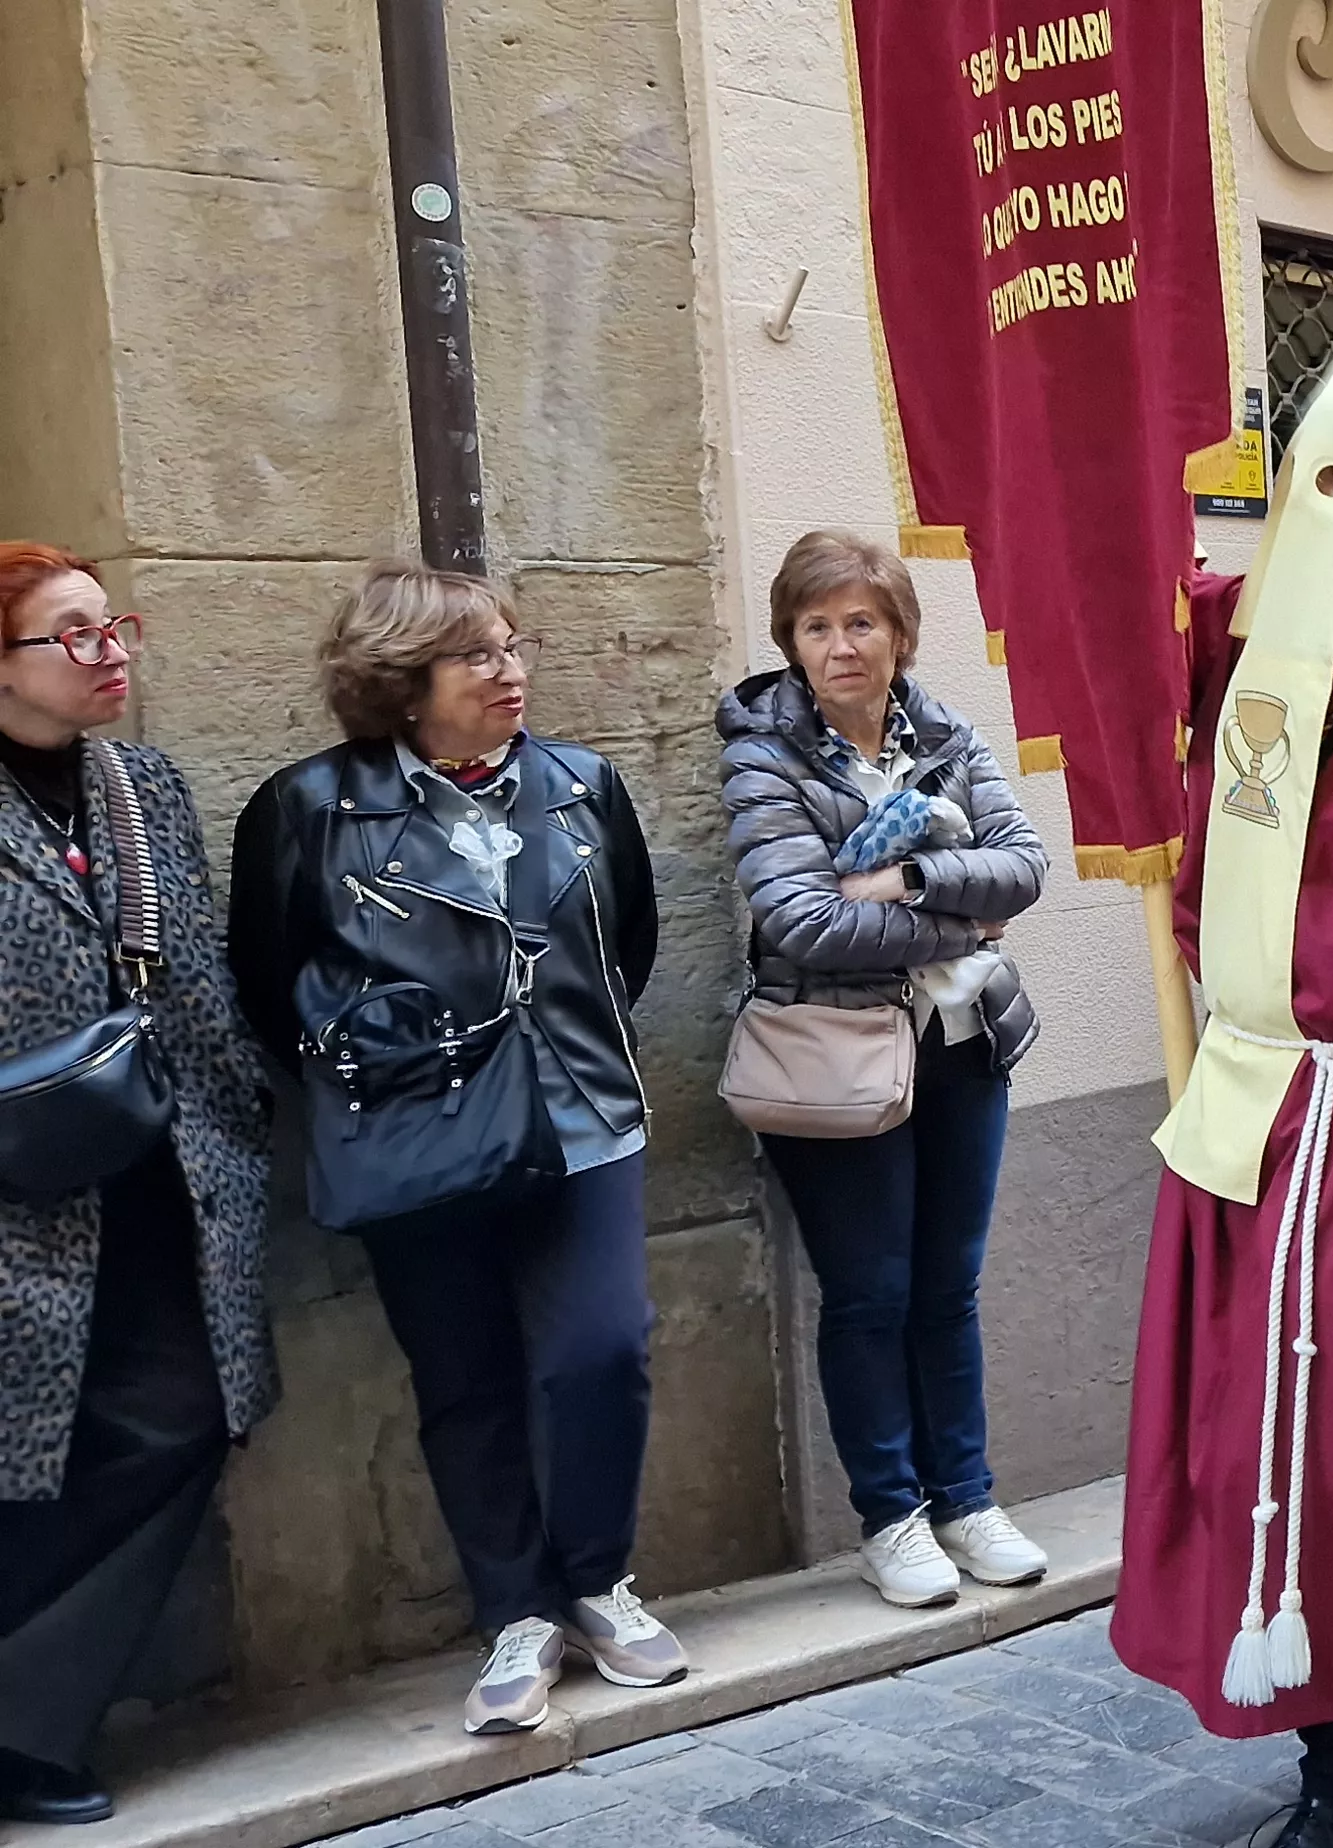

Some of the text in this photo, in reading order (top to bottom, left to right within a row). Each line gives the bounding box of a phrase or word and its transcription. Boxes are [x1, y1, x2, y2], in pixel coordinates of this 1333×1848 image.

[1008, 103, 1067, 150] LOS
[1072, 89, 1123, 144] PIES
[1009, 186, 1040, 234] YO
[1046, 175, 1124, 228] HAGO
